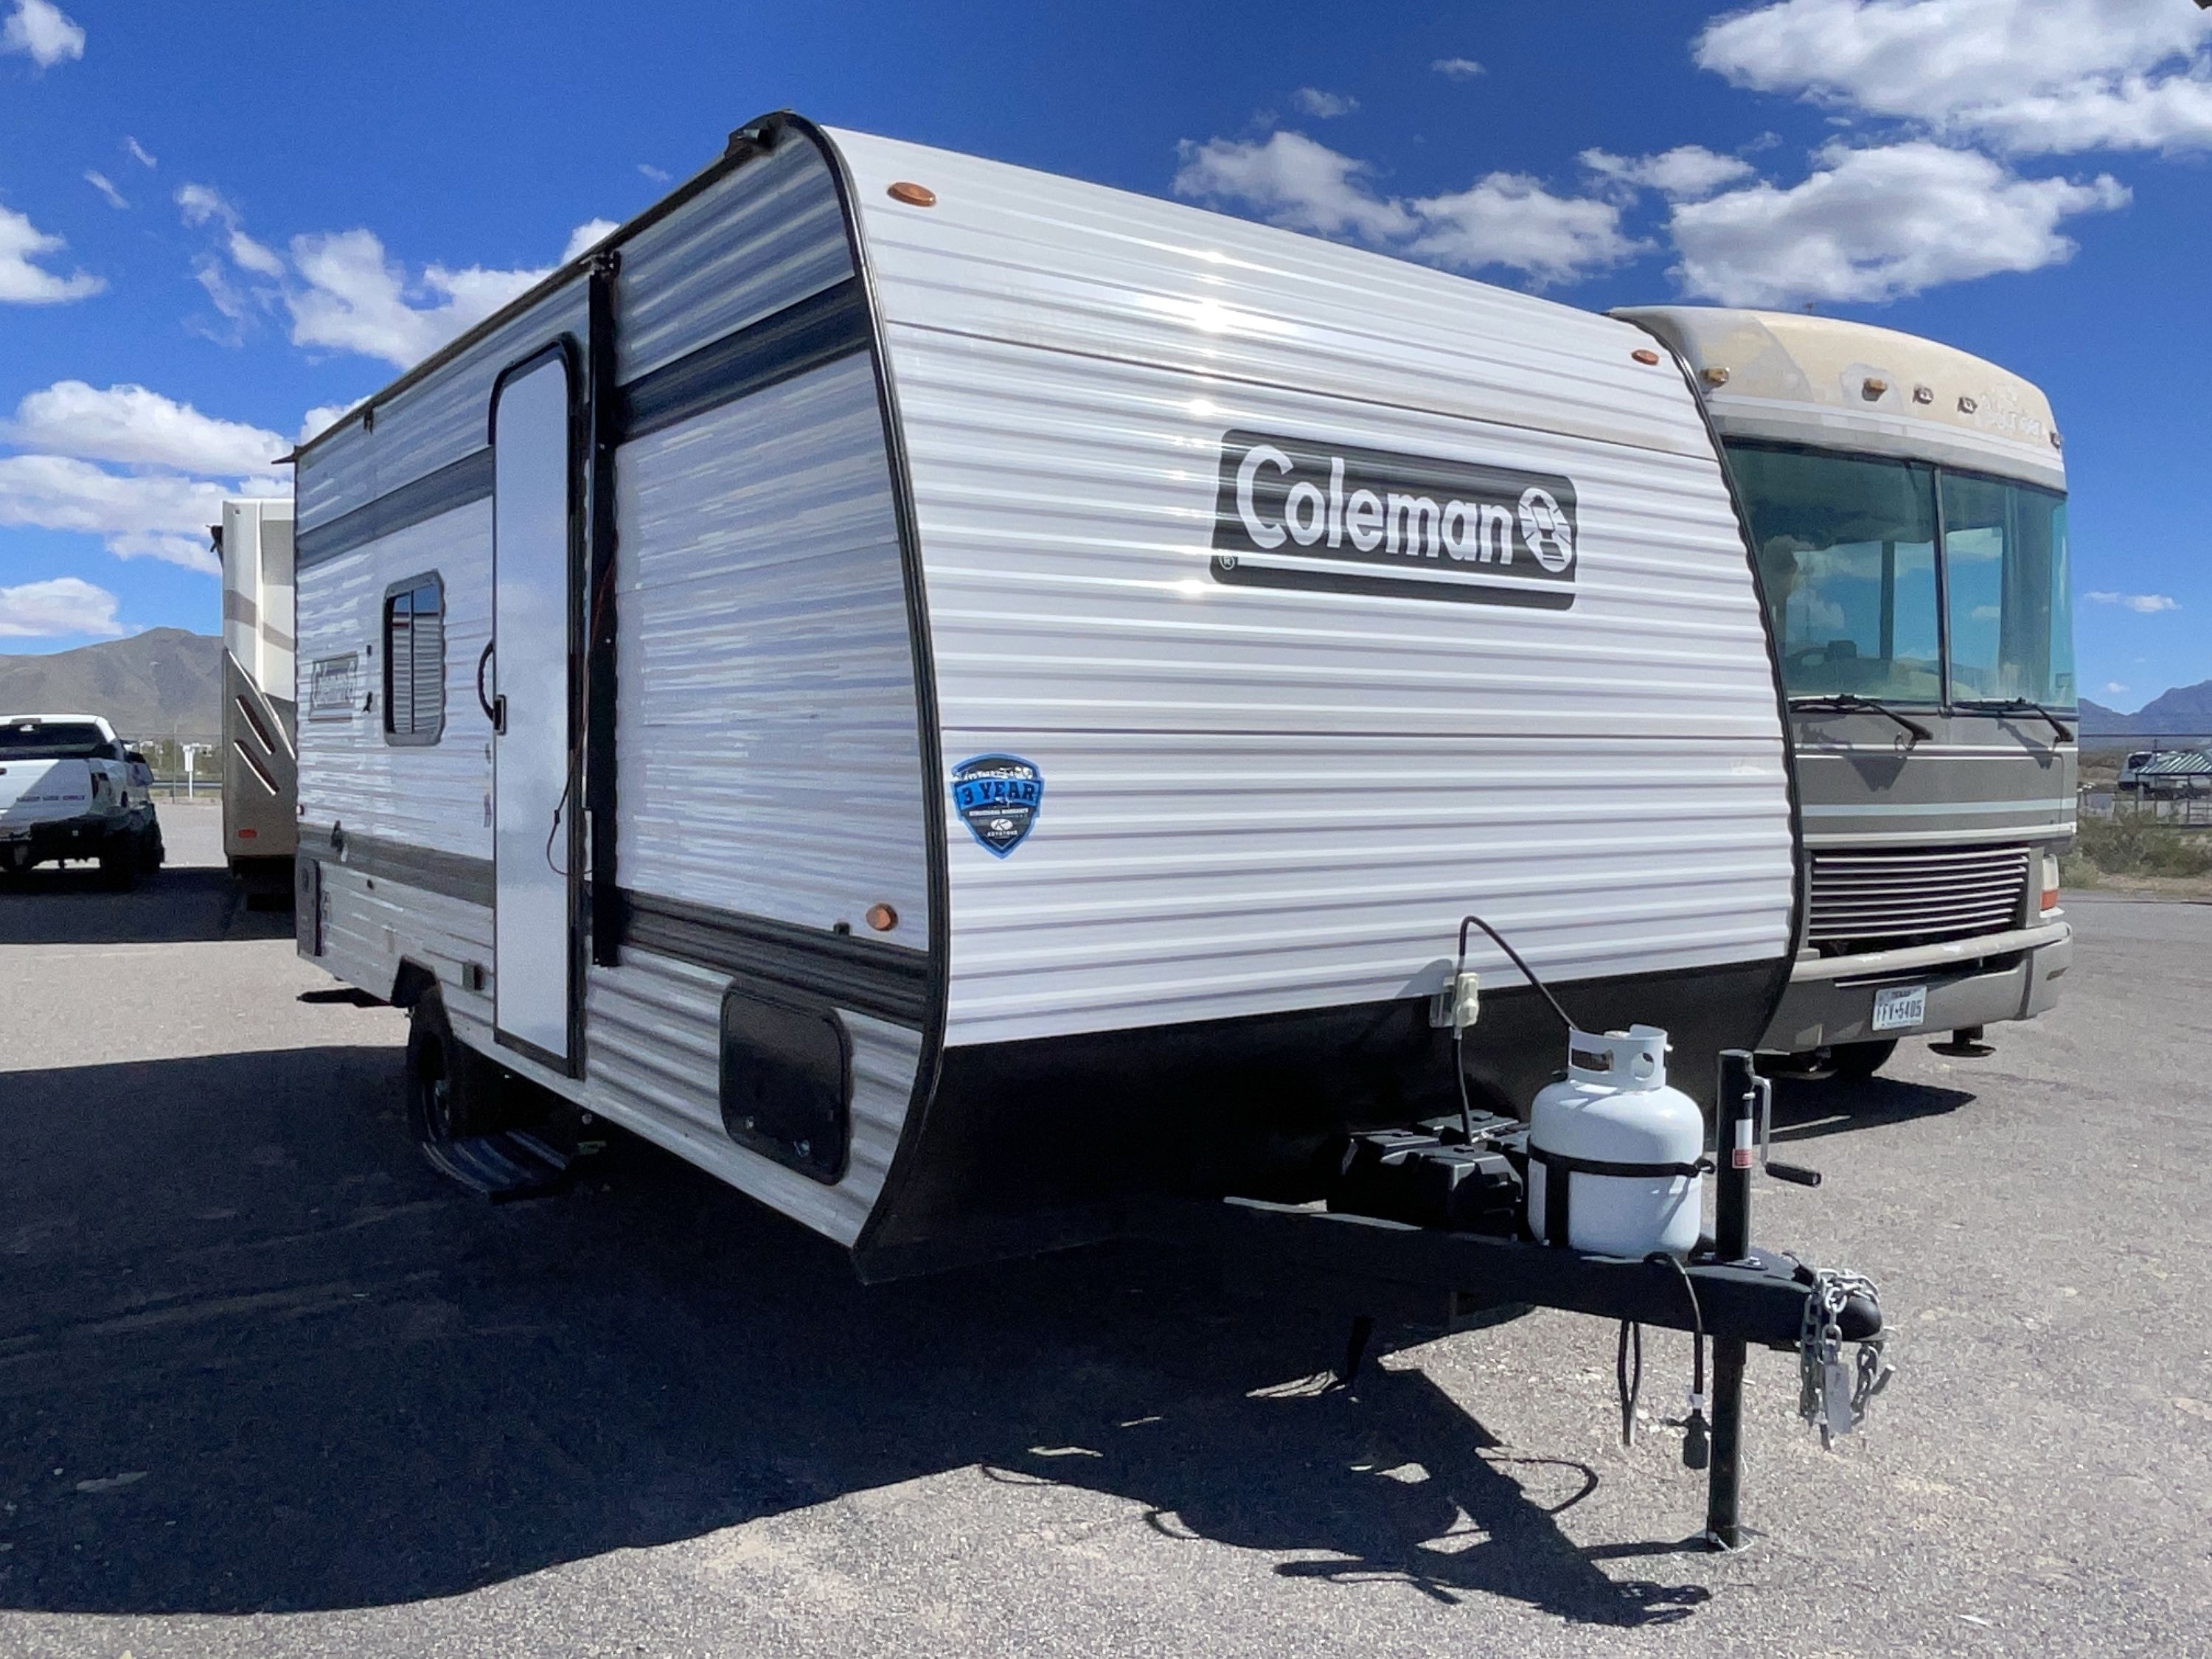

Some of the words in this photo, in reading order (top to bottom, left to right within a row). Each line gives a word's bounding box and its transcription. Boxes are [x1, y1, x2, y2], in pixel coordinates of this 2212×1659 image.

[1237, 444, 1513, 566] Coleman
[961, 787, 974, 805] 3
[979, 781, 1035, 800] YEAR
